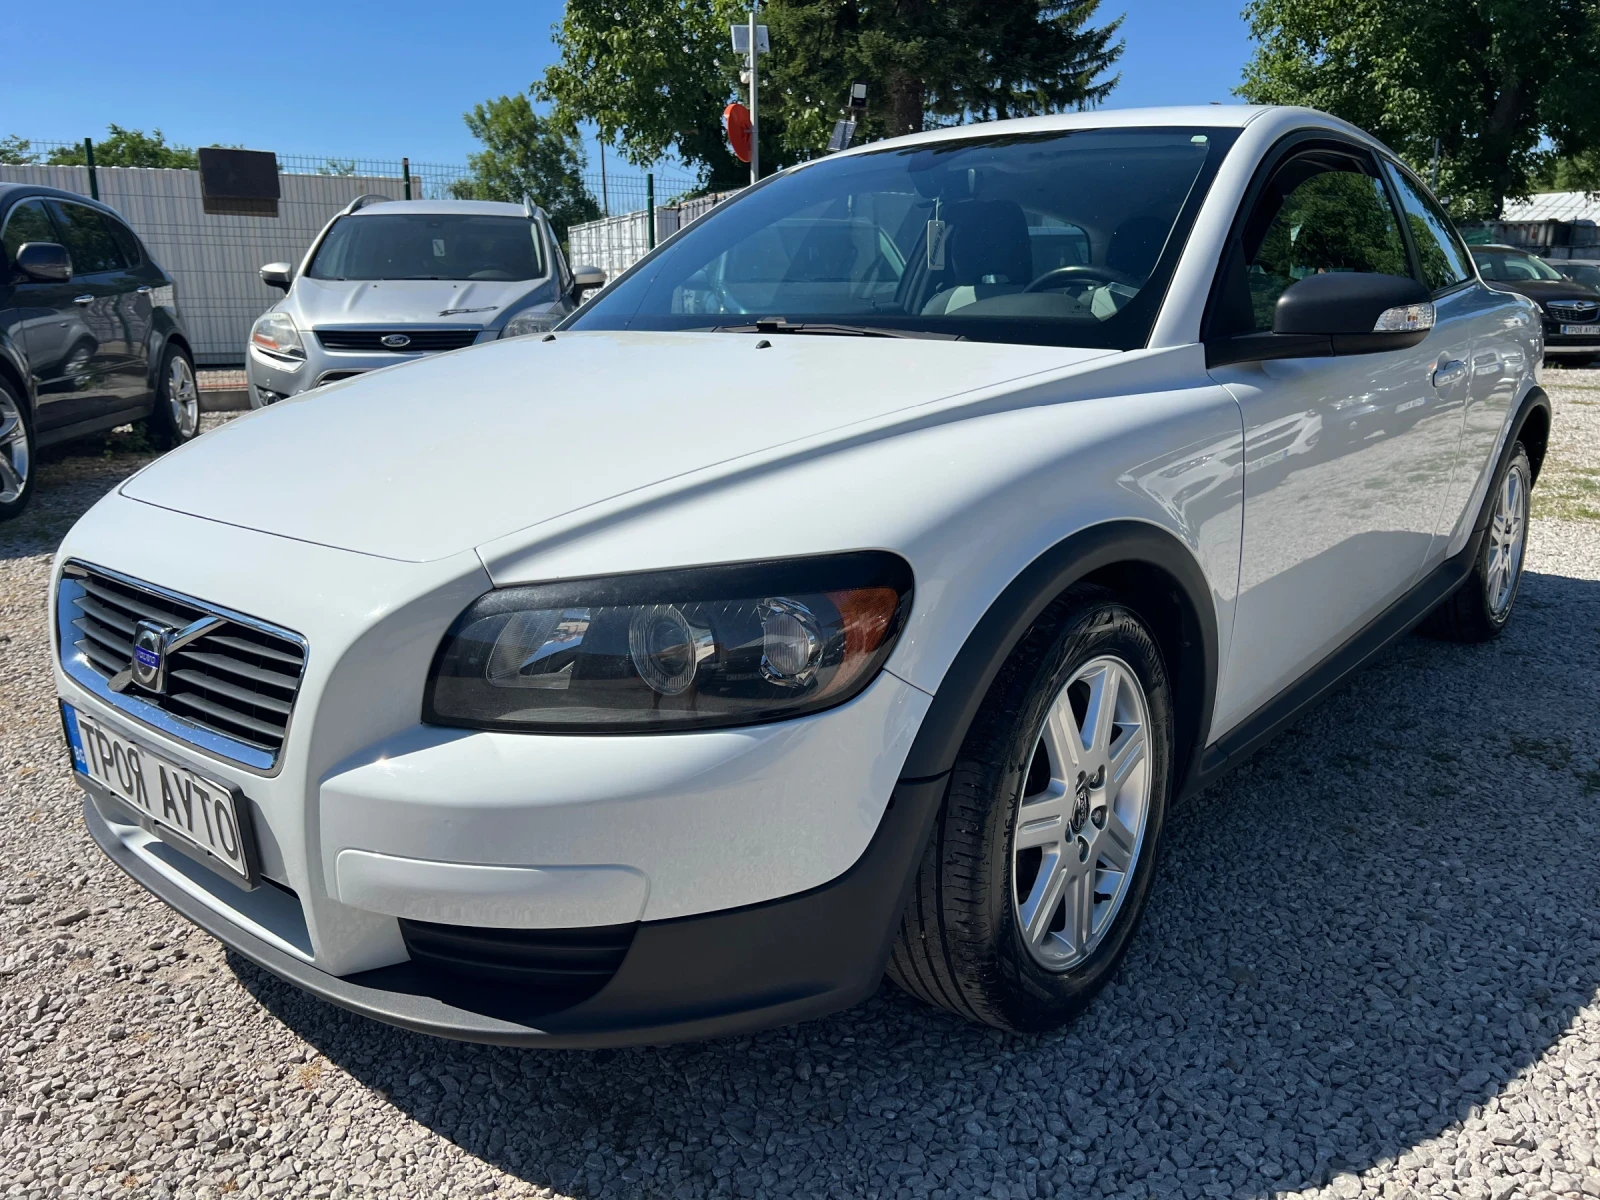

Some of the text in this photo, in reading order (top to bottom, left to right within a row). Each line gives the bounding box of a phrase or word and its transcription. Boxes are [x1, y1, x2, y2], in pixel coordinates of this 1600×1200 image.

[74, 745, 86, 764] BG
[78, 718, 239, 861] ТРОЯ АУТО
